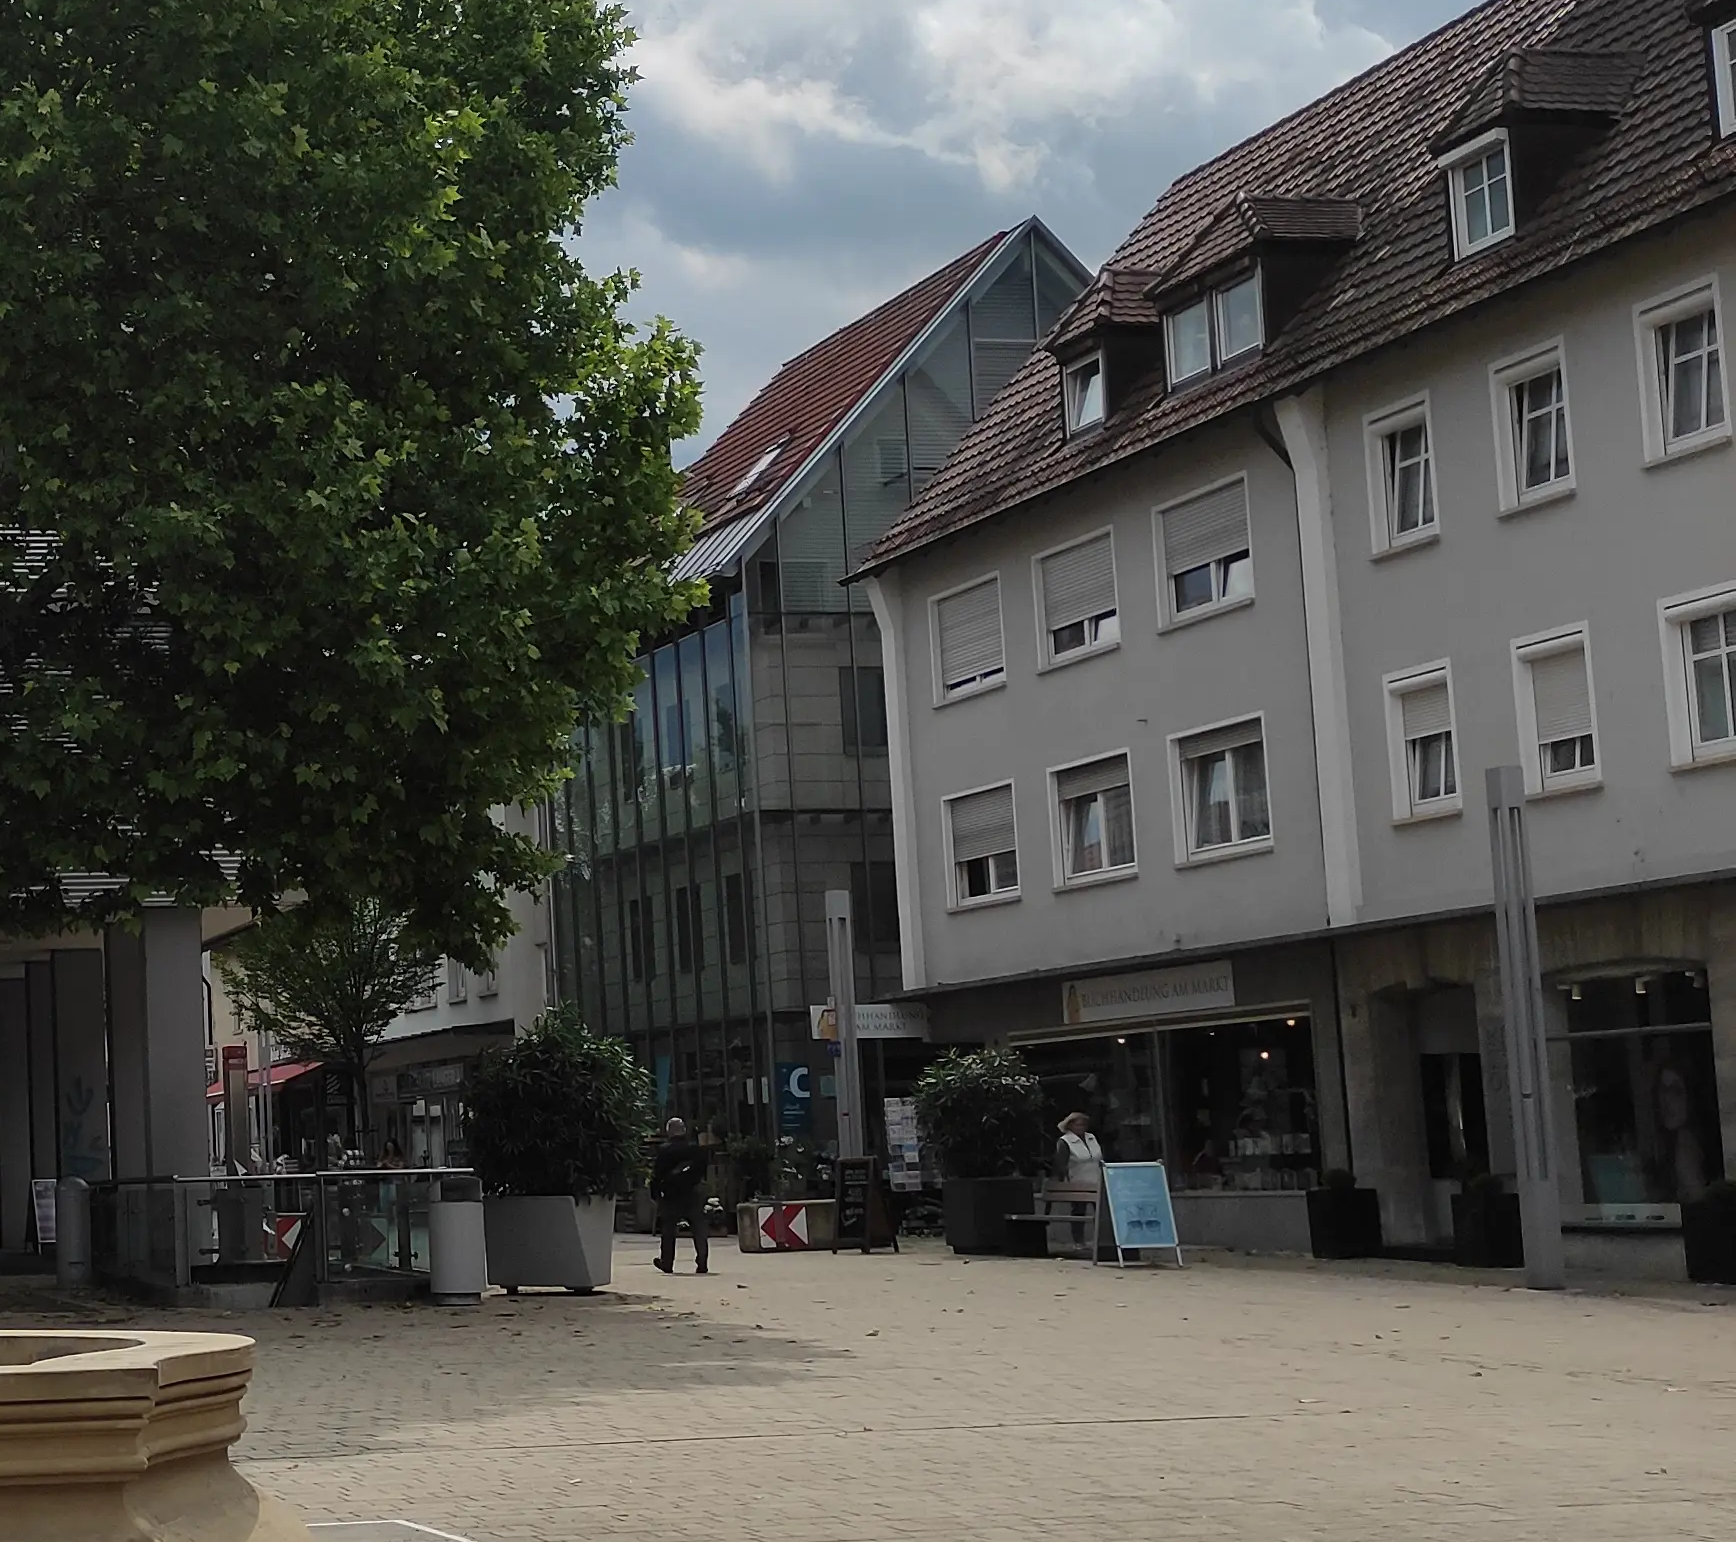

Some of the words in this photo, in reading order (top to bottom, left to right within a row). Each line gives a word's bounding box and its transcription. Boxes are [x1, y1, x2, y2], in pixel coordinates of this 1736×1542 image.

[1082, 983, 1170, 1008] BUCHHANDLUNG
[1171, 981, 1188, 998] AM
[1191, 975, 1229, 994] MARKT
